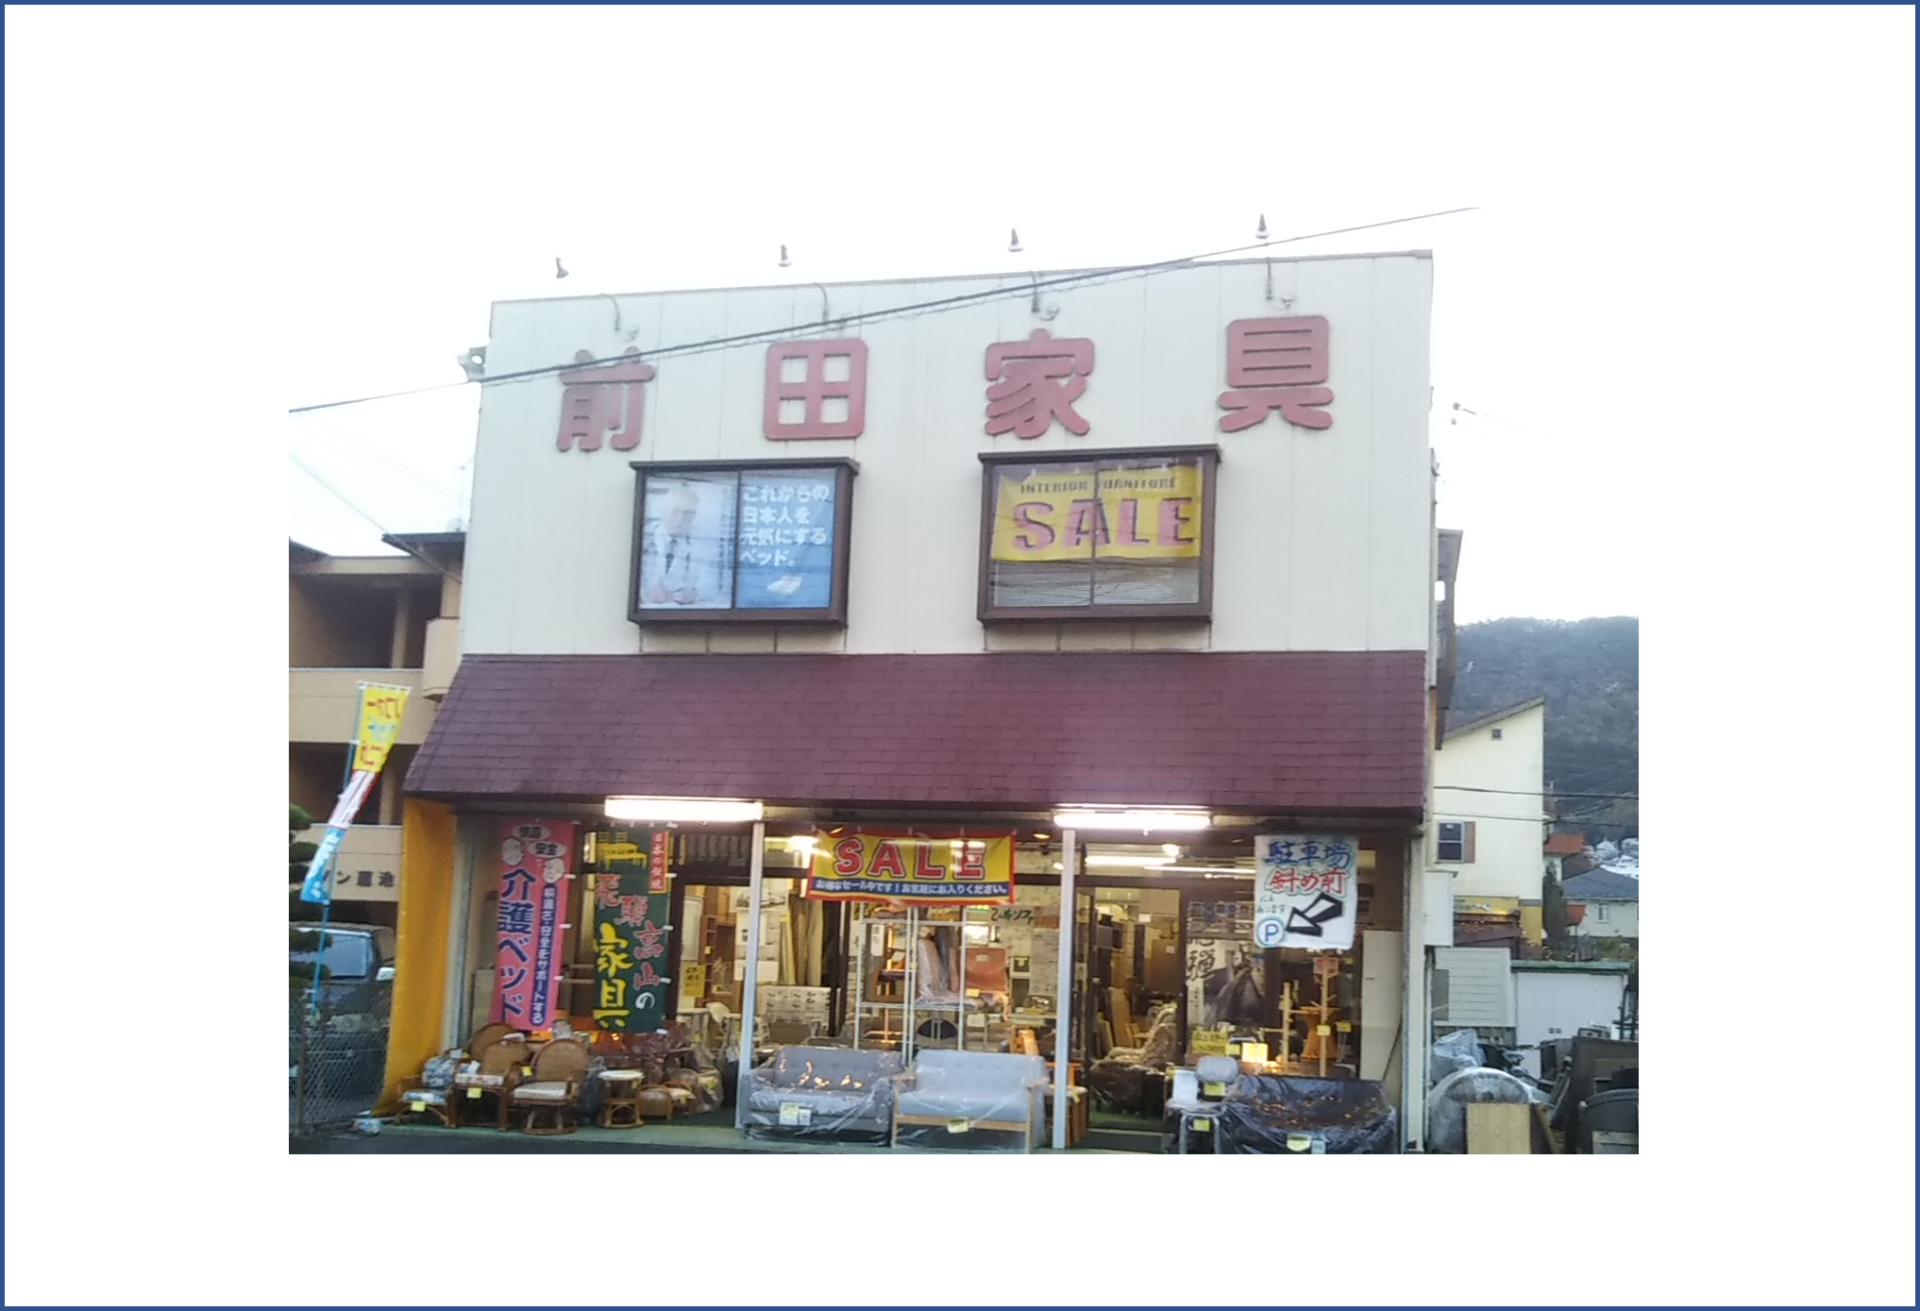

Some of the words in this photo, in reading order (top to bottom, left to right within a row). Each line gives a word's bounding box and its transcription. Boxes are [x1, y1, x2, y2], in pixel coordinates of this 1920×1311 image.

[557, 316, 1334, 452] 前田家具
[743, 485, 829, 503] これからの
[1020, 481, 1088, 494] INTERIOR
[743, 506, 811, 524] 日本人を
[1013, 497, 1194, 552] SALE
[741, 527, 827, 547] 元気にする
[740, 550, 796, 567] ベッド。
[833, 838, 985, 880] SALE
[1264, 841, 1351, 869] 駐車場
[1269, 867, 1347, 894] 斜め前
[497, 868, 537, 1023] 介護ベッド
[593, 922, 634, 1028] 家具
